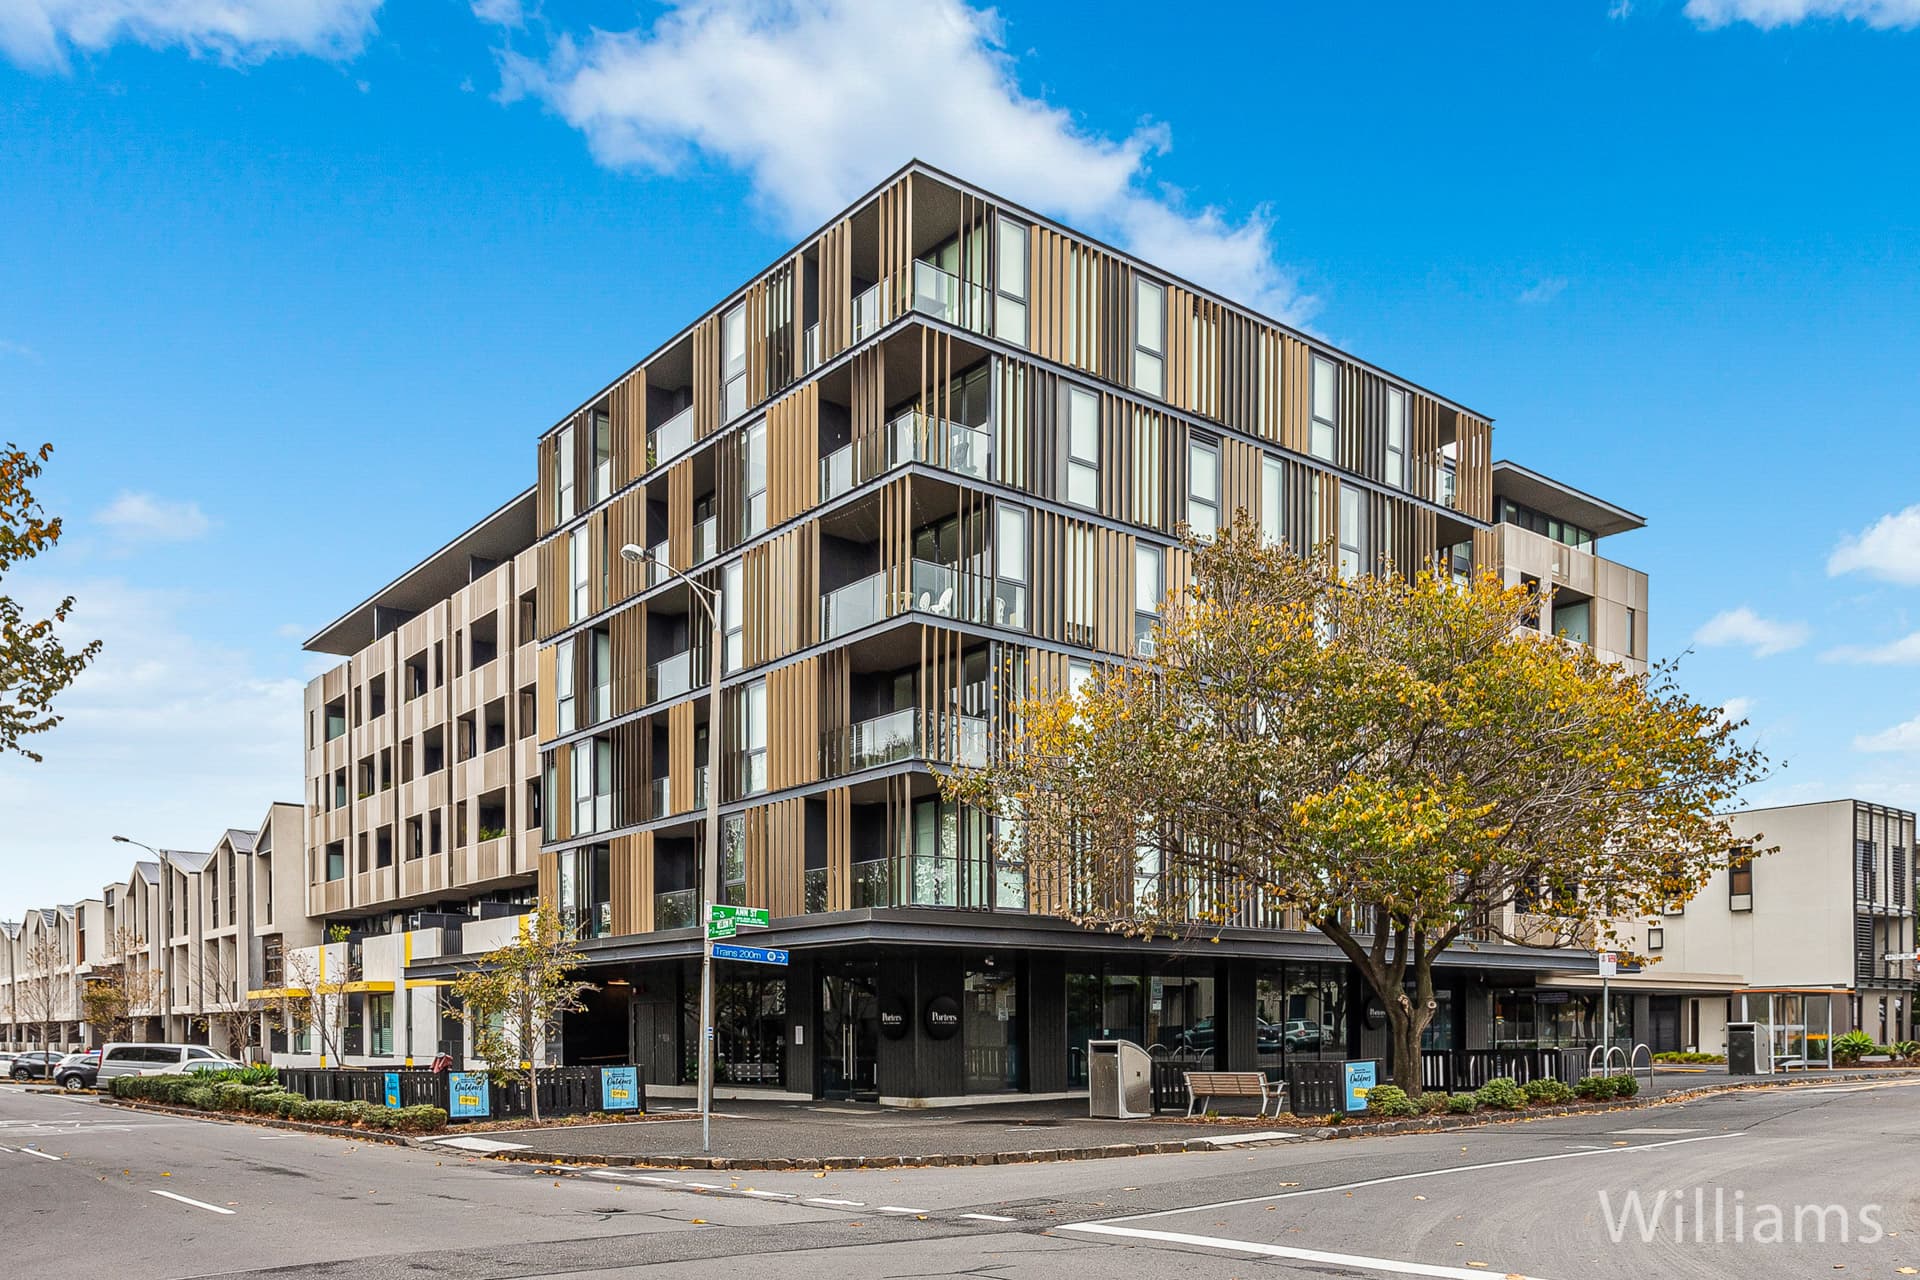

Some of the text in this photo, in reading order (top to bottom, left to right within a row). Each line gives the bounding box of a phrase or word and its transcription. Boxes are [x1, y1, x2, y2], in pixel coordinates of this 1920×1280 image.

[736, 908, 757, 917] ANN ST
[715, 946, 761, 959] Trains 200m
[932, 1011, 957, 1022] Porters
